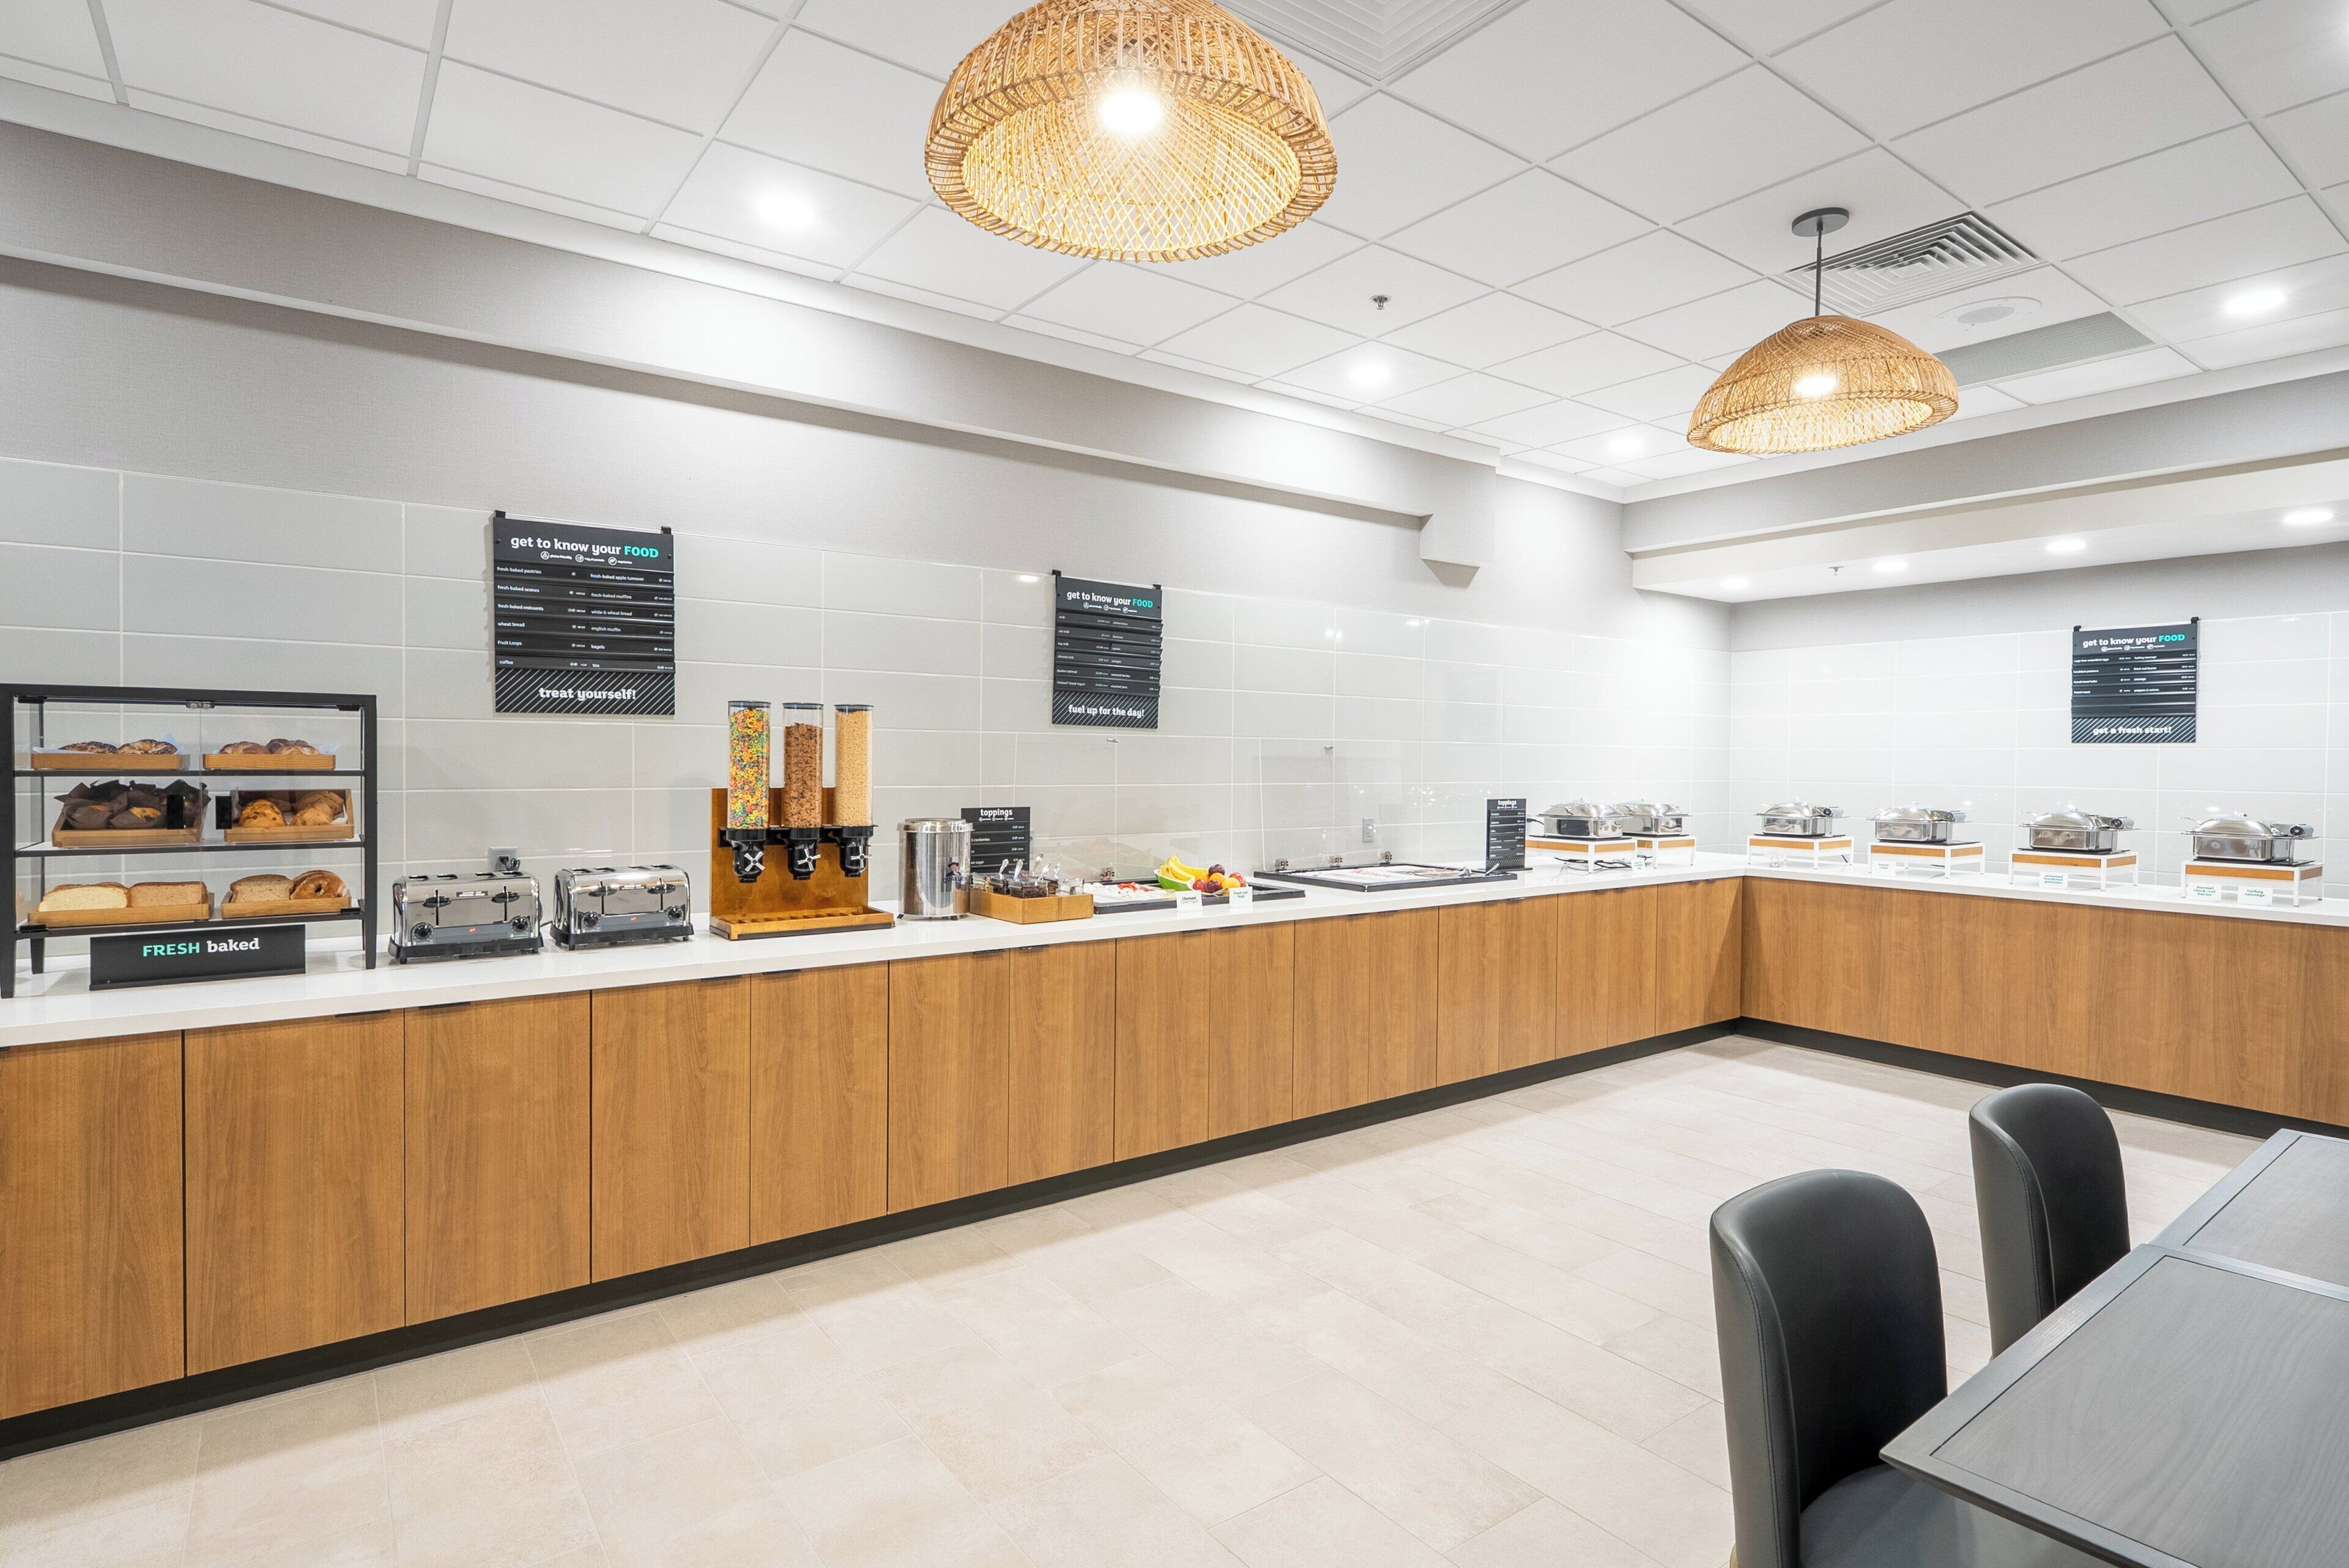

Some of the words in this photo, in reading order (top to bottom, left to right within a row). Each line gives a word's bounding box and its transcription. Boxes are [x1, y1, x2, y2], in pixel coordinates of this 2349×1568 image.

[511, 538, 533, 549] get
[536, 538, 551, 549] to
[554, 539, 589, 552] know
[592, 545, 621, 555] your
[624, 545, 659, 558] FOOD
[1067, 591, 1080, 600] get
[1091, 593, 1112, 603] know
[1113, 597, 1131, 606] your
[1133, 599, 1153, 608] FOOD
[2082, 639, 2098, 648] get
[2136, 637, 2157, 645] your
[539, 688, 574, 698] treat
[577, 689, 636, 701] yourself!
[1069, 704, 1085, 713] fuel
[1087, 708, 1097, 716] up
[1099, 706, 1111, 715] for
[1112, 707, 1126, 716] the
[1127, 708, 1145, 719] day!
[980, 808, 1013, 818] toppings
[143, 942, 200, 957] FRESH
[206, 937, 260, 953] baked
